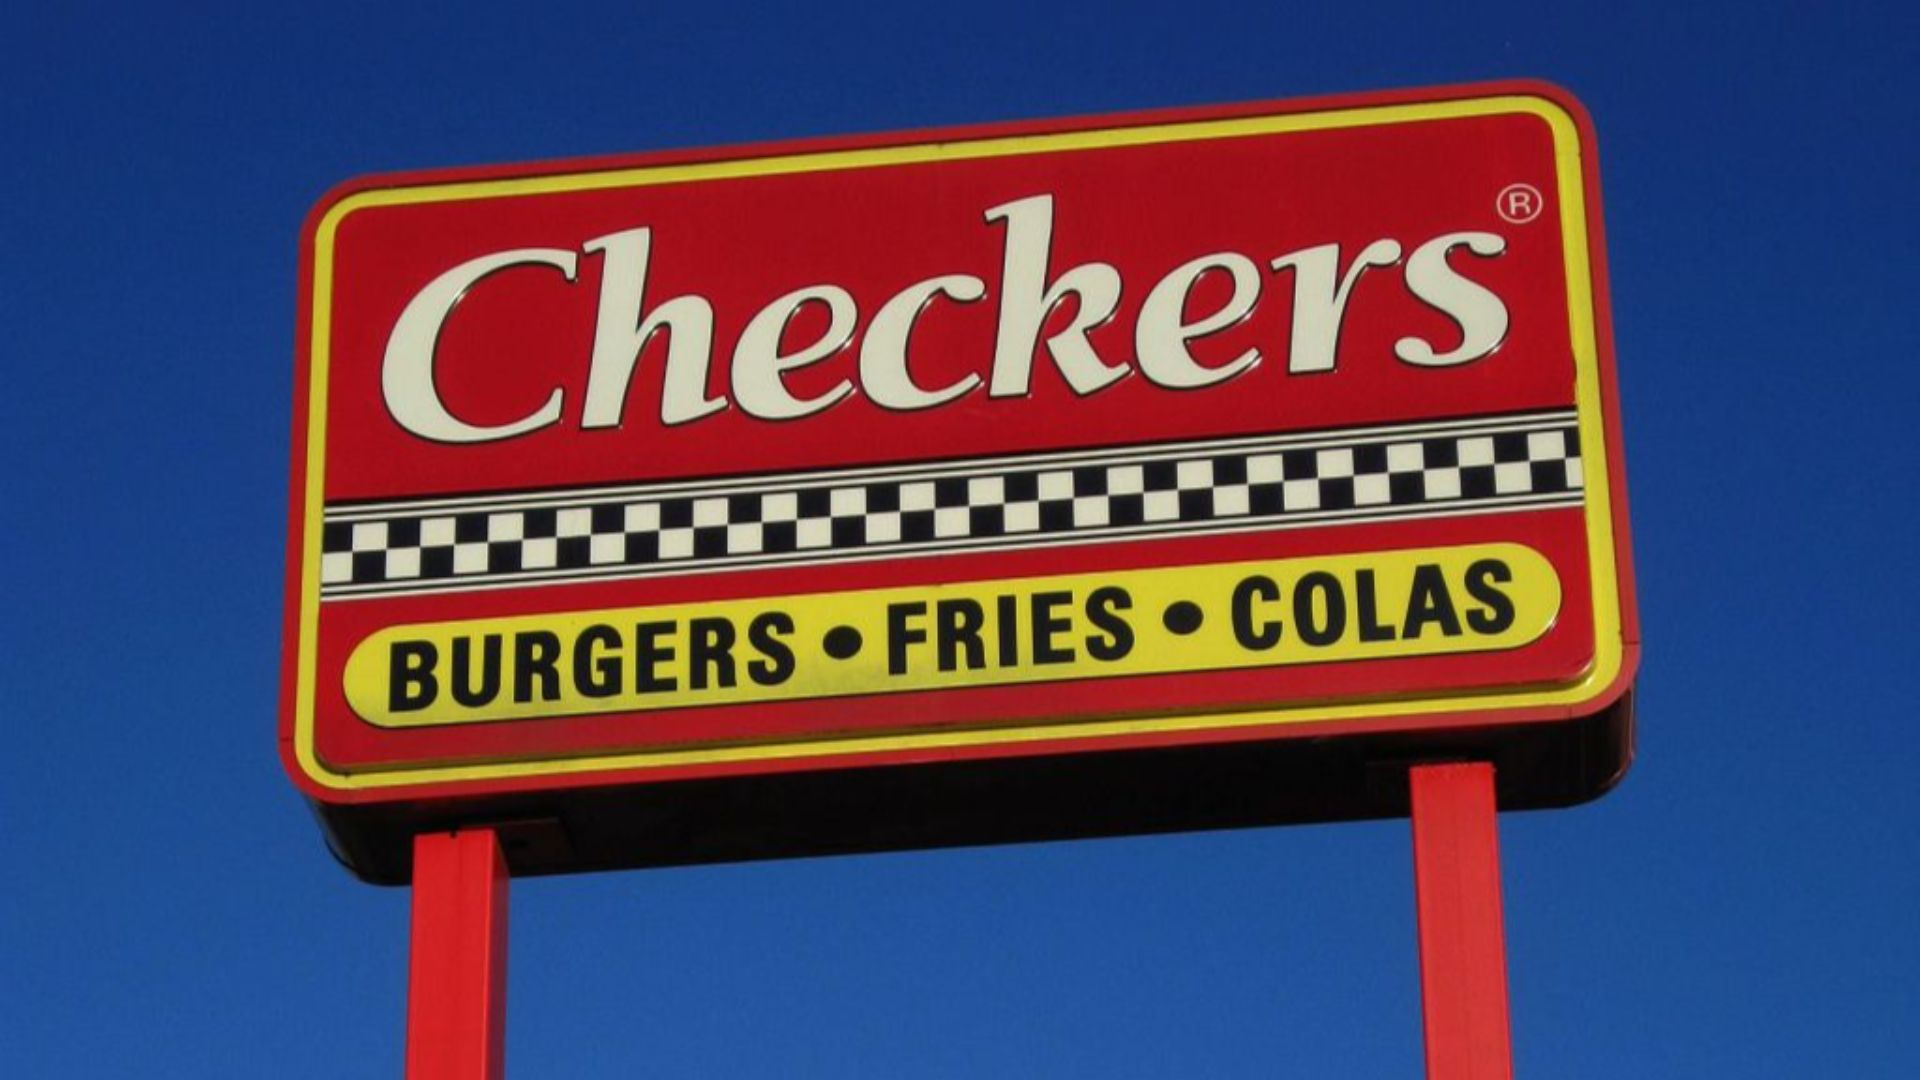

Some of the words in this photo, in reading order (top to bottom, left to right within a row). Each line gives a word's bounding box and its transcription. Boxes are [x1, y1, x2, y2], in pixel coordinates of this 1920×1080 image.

[380, 192, 1509, 446] Checkers
[387, 611, 797, 713] BURGERS
[886, 585, 1136, 676] FRIES
[1230, 557, 1517, 652] COLAS
